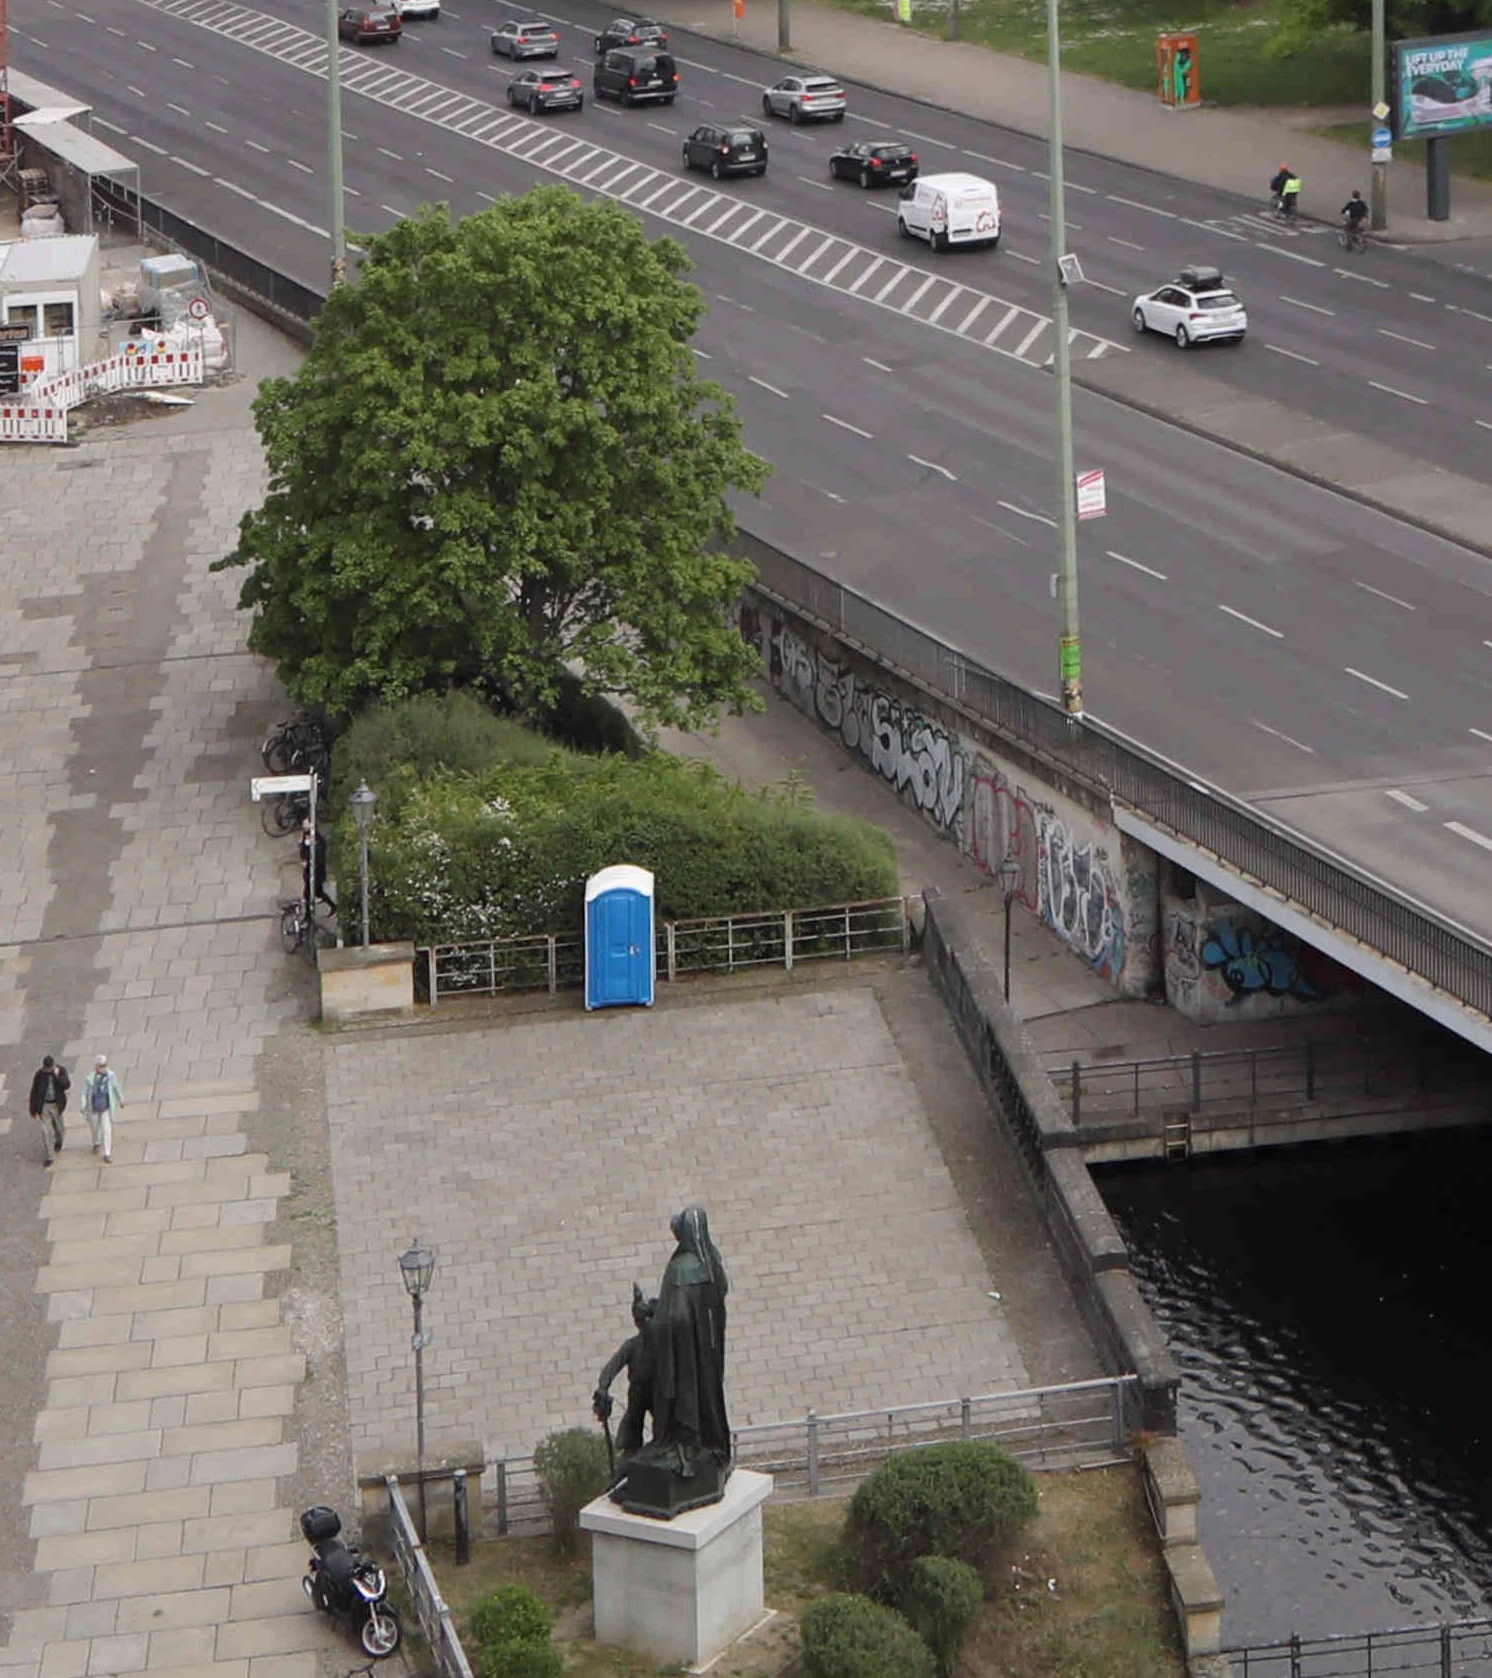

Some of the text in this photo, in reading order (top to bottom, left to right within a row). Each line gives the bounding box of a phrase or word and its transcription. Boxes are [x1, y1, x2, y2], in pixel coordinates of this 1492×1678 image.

[1405, 47, 1469, 68] LIFT UP THE
[1406, 60, 1464, 78] EVERYDAY
